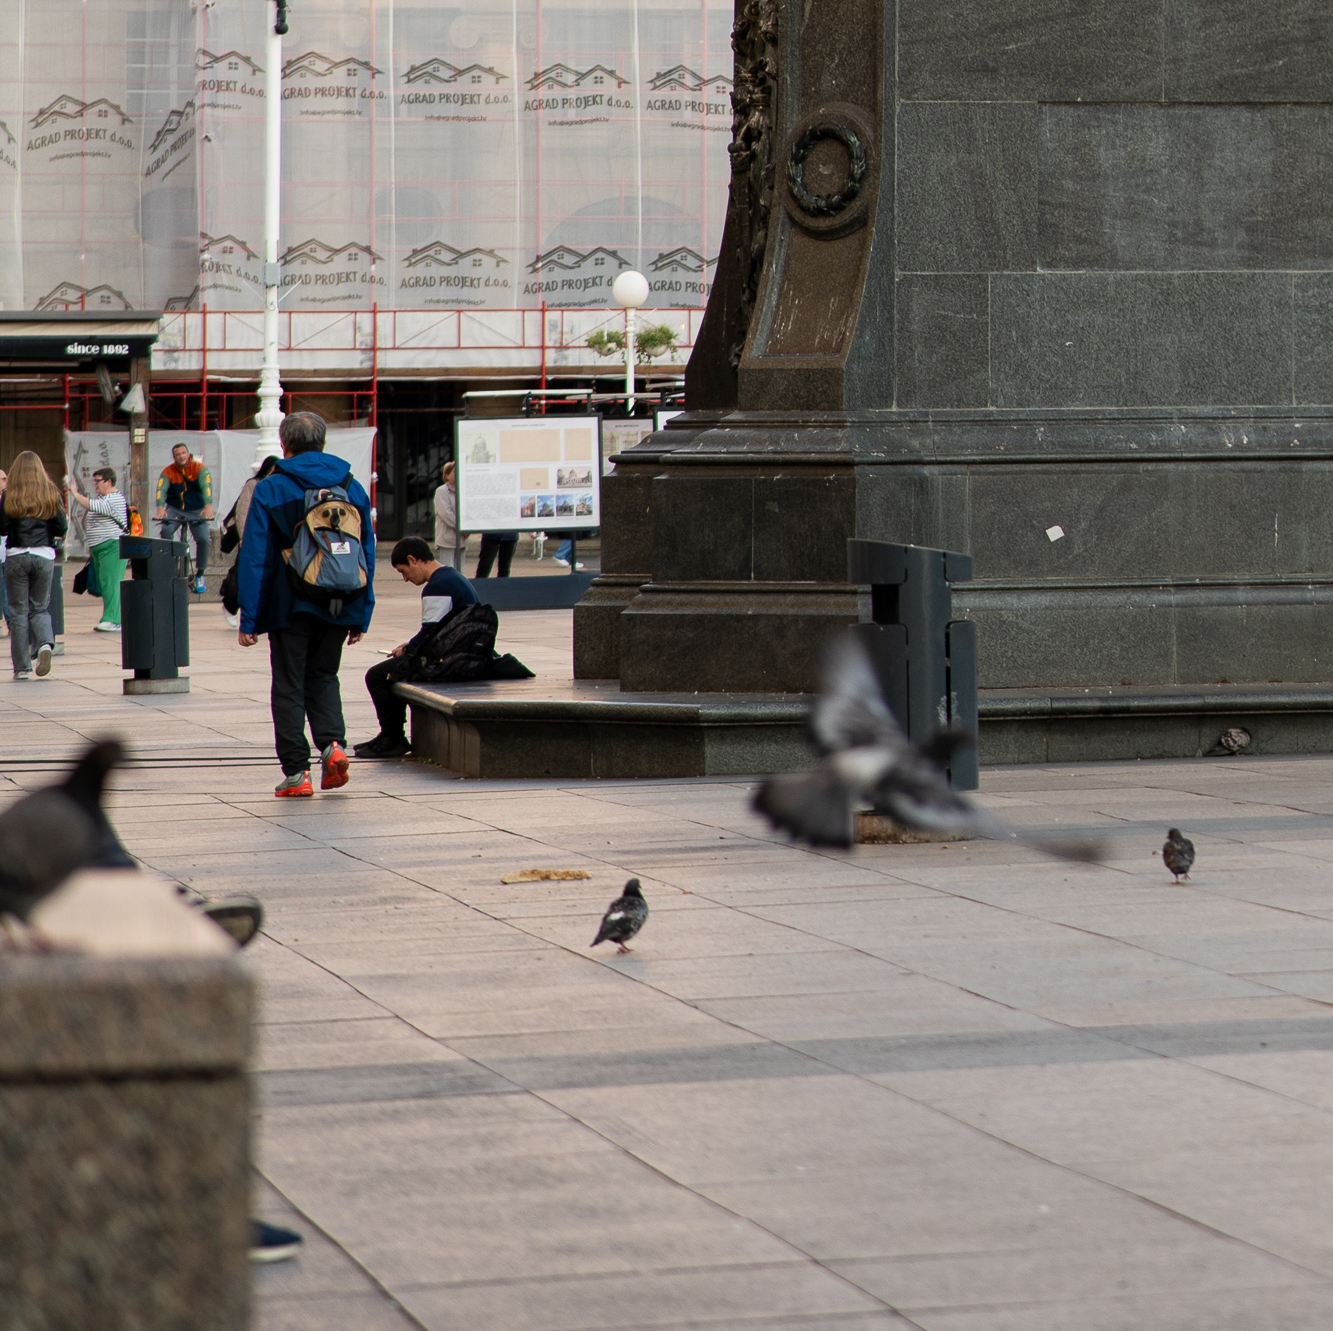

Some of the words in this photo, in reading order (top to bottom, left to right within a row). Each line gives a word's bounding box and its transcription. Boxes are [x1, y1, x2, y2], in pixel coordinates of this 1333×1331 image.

[314, 87, 358, 99] PROJEKT
[400, 93, 436, 104] AGRAD
[439, 93, 482, 105] PROJEKT
[524, 97, 560, 112] AGRAD
[563, 95, 604, 110] PROJEKT
[646, 100, 682, 112] AGRAD
[685, 100, 726, 116] PROJEKT
[548, 117, 610, 127] info@agradprojekt.hr
[27, 132, 61, 151] AGRAD
[64, 128, 108, 141] PROJEKT
[315, 272, 358, 285] PROJEKT
[400, 276, 436, 288] AGRAD
[439, 275, 482, 288] PROJEKT
[524, 280, 559, 295] AGRAD
[562, 277, 604, 292] PROJEKT
[424, 297, 486, 305] info@agradprojekt.hr
[67, 344, 99, 354] since
[103, 346, 129, 354] 1892
